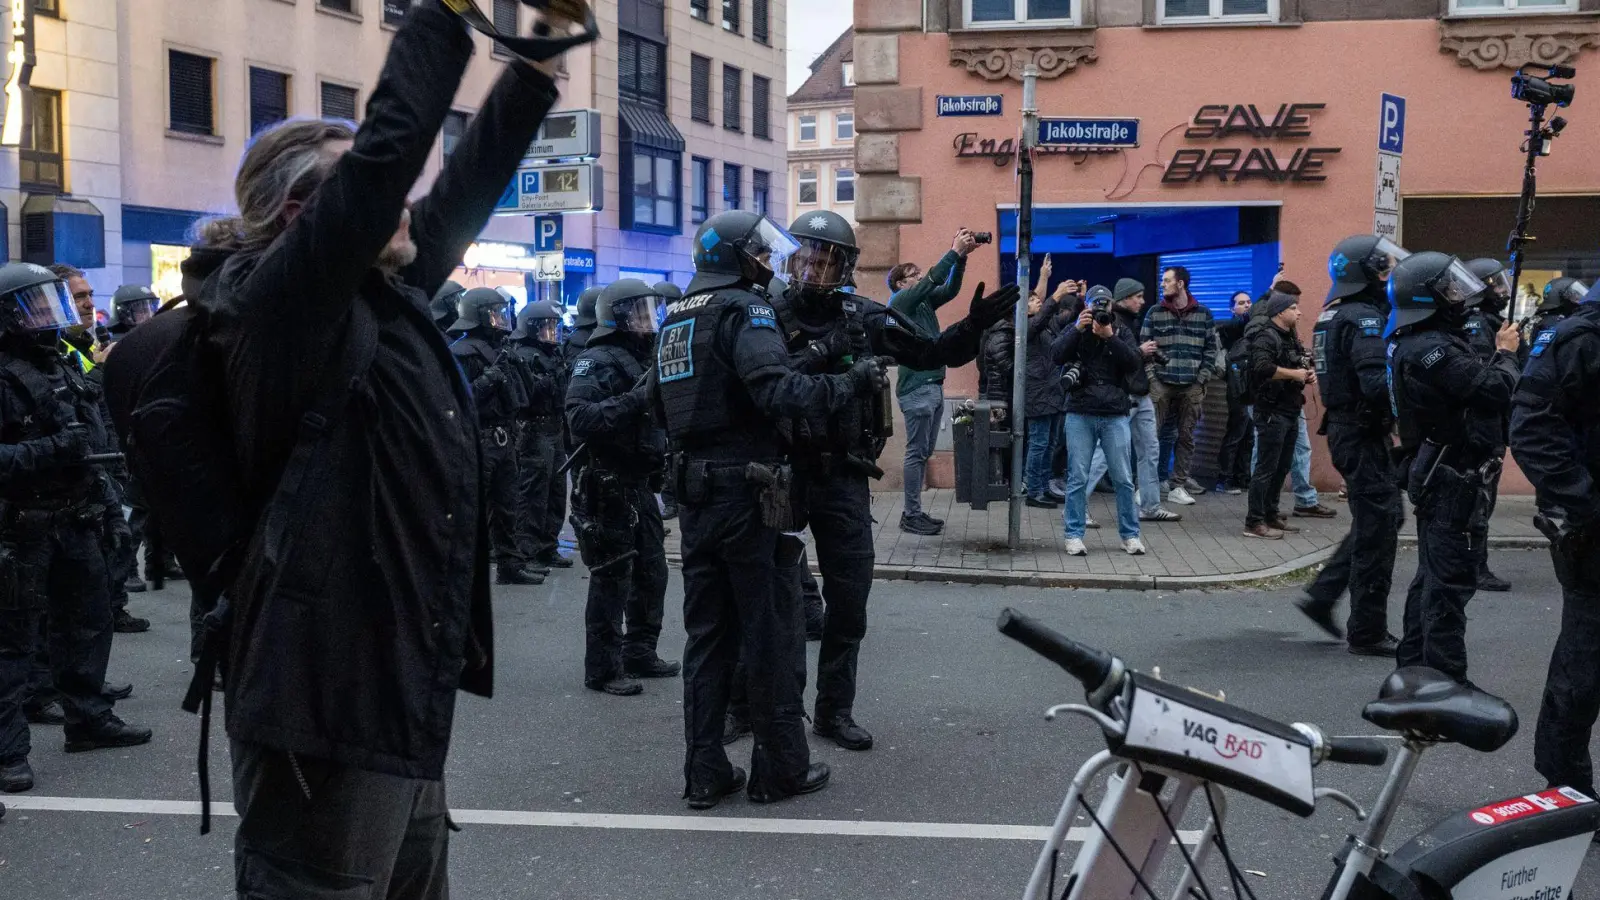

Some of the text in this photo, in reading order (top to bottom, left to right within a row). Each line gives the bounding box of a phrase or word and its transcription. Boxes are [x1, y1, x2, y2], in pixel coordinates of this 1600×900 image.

[940, 98, 998, 114] Jakobstraße
[1184, 103, 1326, 138] SAVE
[1382, 101, 1399, 144] P
[1047, 122, 1129, 140] Jakobstraße
[527, 144, 554, 154] aximum
[1161, 148, 1342, 183] BRAVE
[525, 175, 535, 192] P
[541, 220, 557, 248] P
[585, 257, 593, 267] 20
[666, 294, 714, 316] POLIZEI
[752, 307, 772, 317] USK
[668, 326, 684, 344] BY
[1425, 351, 1443, 366] USK
[1183, 718, 1263, 760] VAG RAD
[1501, 865, 1538, 891] Fürther
